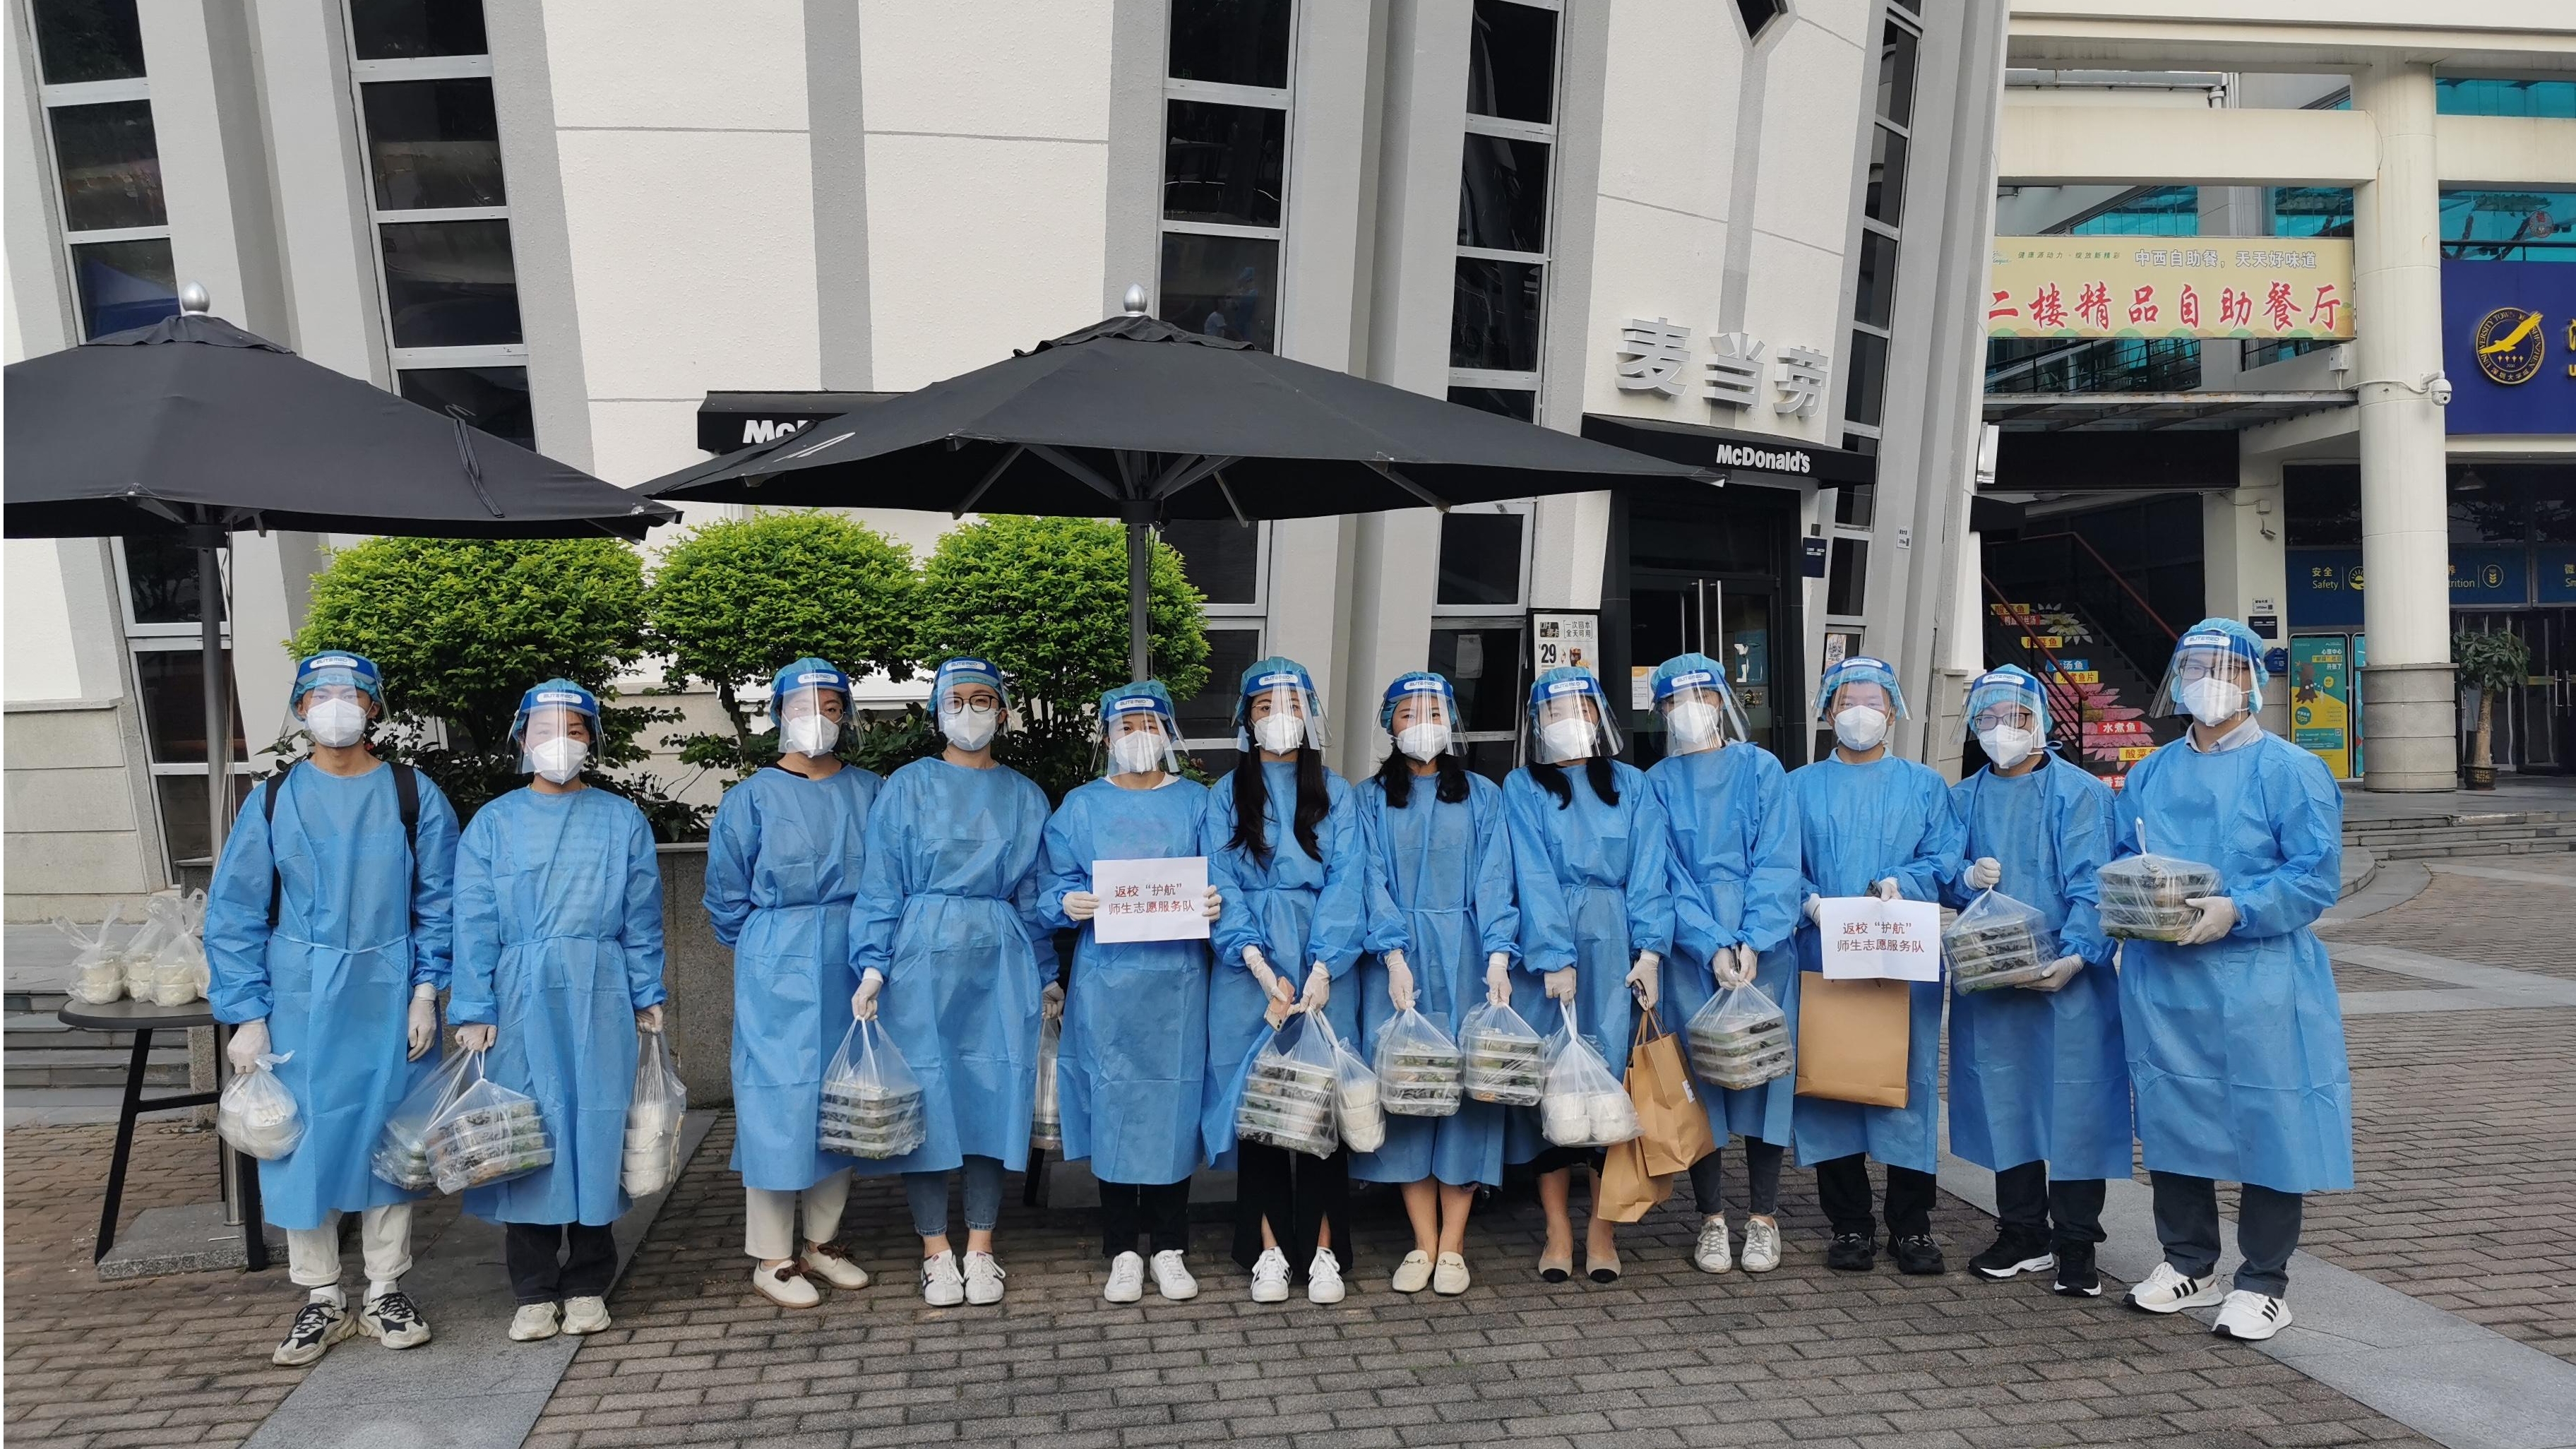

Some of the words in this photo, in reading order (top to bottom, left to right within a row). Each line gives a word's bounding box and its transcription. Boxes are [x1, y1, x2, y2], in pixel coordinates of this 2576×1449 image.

[1988, 280, 2341, 330] 二楼精品自助餐厅
[1615, 317, 1828, 417] 麦当劳
[1716, 444, 1811, 473] McDonald's
[2312, 566, 2332, 577] 安全
[2313, 579, 2339, 590] Safety
[1565, 621, 1591, 629] 一次回本
[1566, 629, 1591, 638] 全天可用
[2103, 722, 2136, 733] 水煮鱼
[1109, 900, 1195, 915] 师生志愿服务队
[1837, 939, 1925, 953] 师生志愿服务队
